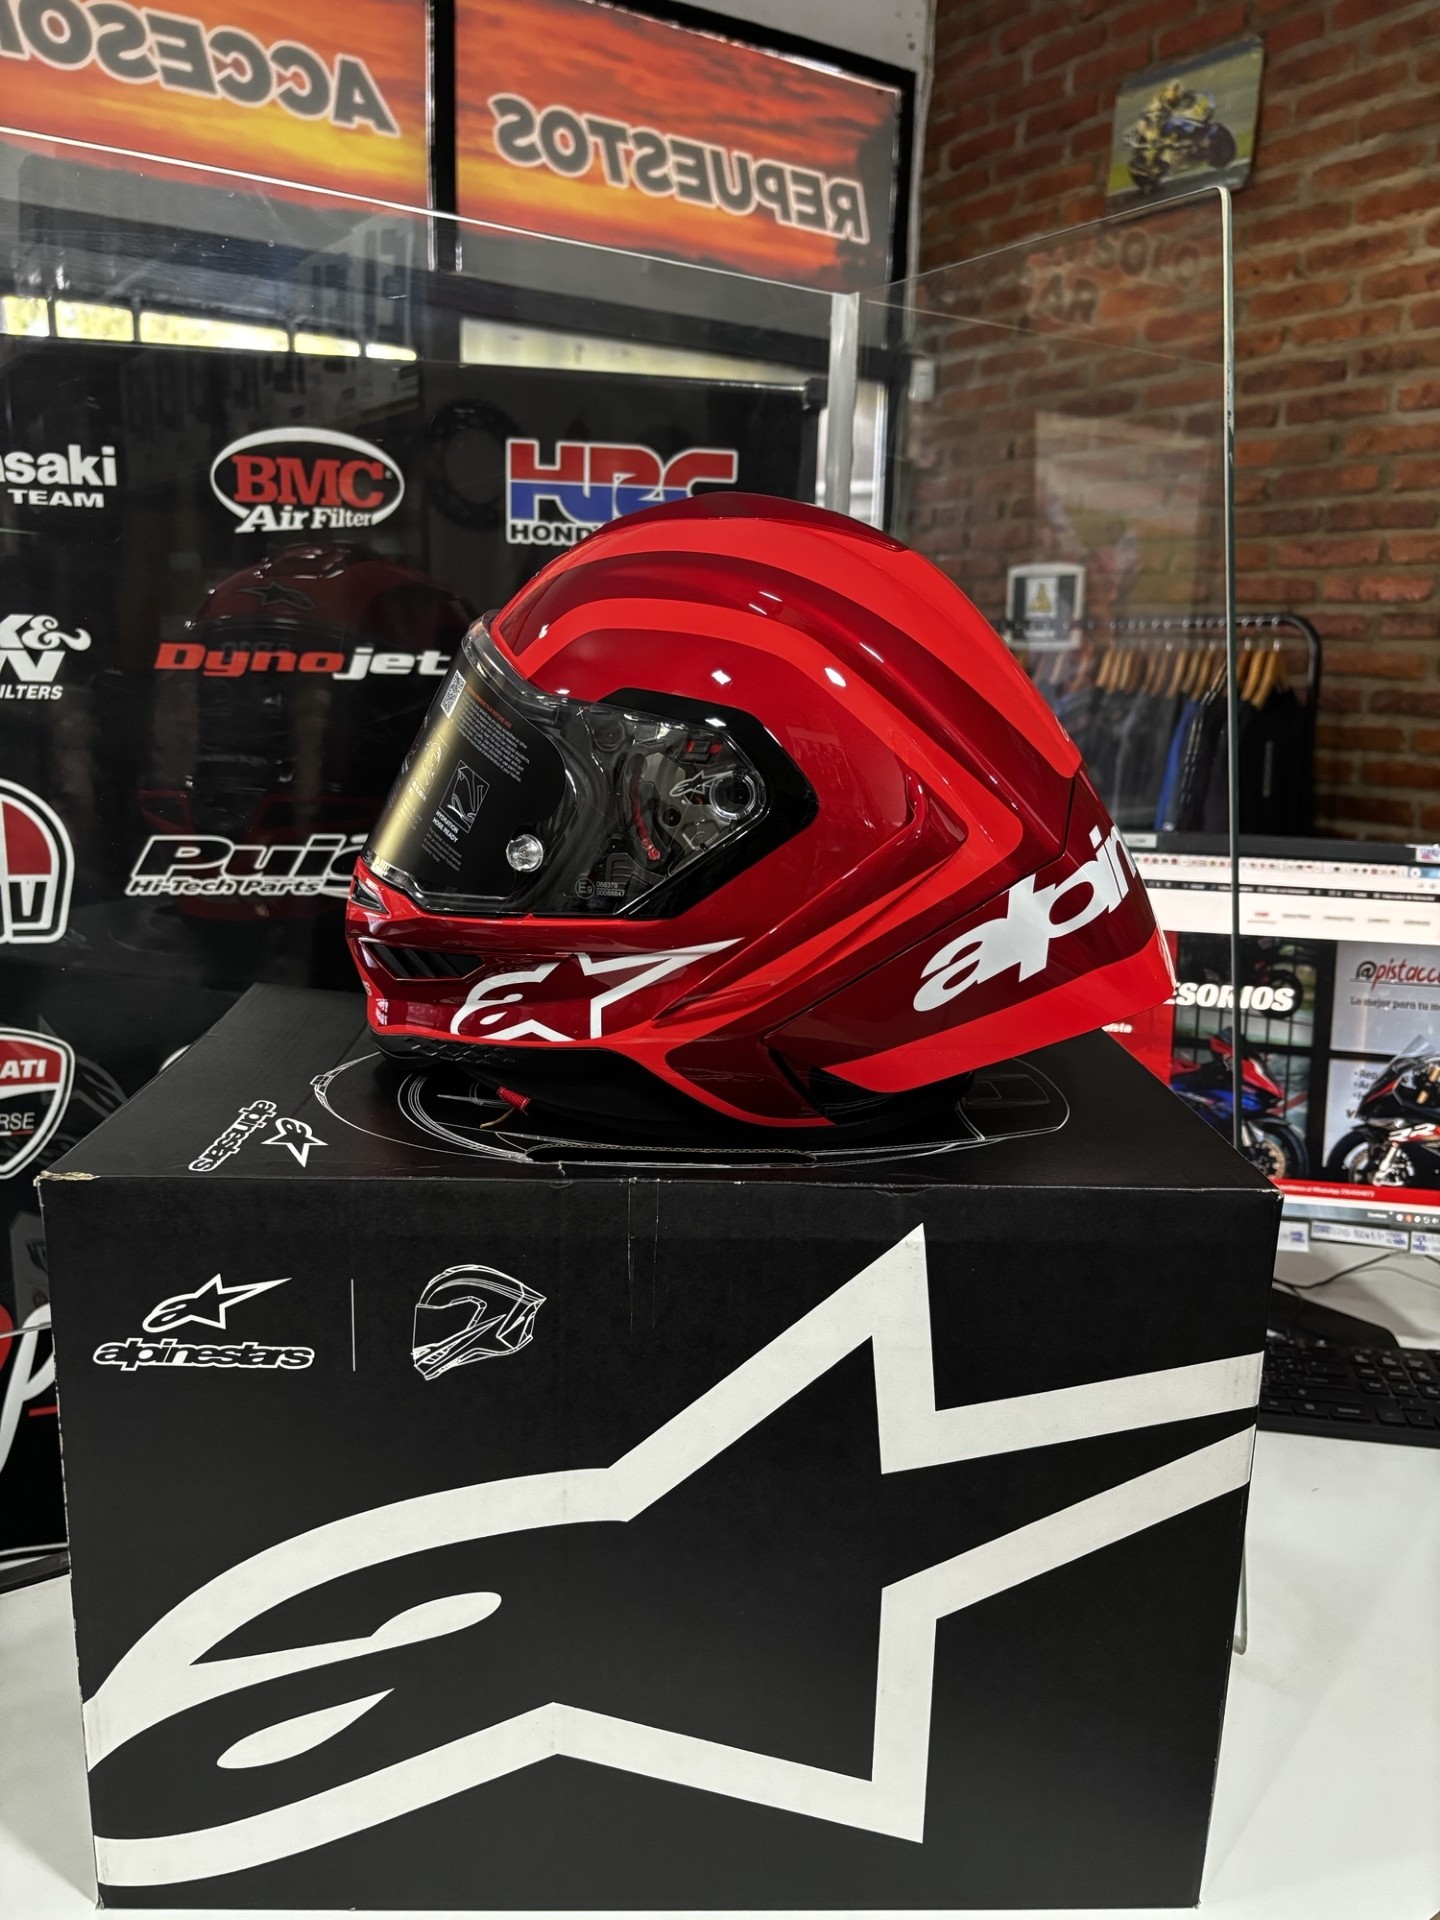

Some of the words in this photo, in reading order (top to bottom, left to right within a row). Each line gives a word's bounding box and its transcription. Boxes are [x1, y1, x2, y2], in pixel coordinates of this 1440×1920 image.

[0, 444, 117, 486] saki
[231, 454, 385, 508] BMC
[7, 488, 105, 508] TEAM
[234, 503, 309, 534] Air
[309, 507, 375, 530] Filter
[507, 522, 602, 546] HOND
[153, 642, 451, 681] Dynojet
[125, 876, 239, 896] Hi-Tech
[240, 876, 323, 896] Parts
[1355, 957, 1440, 992] @pistacc
[93, 1338, 315, 1372] alpinestars
